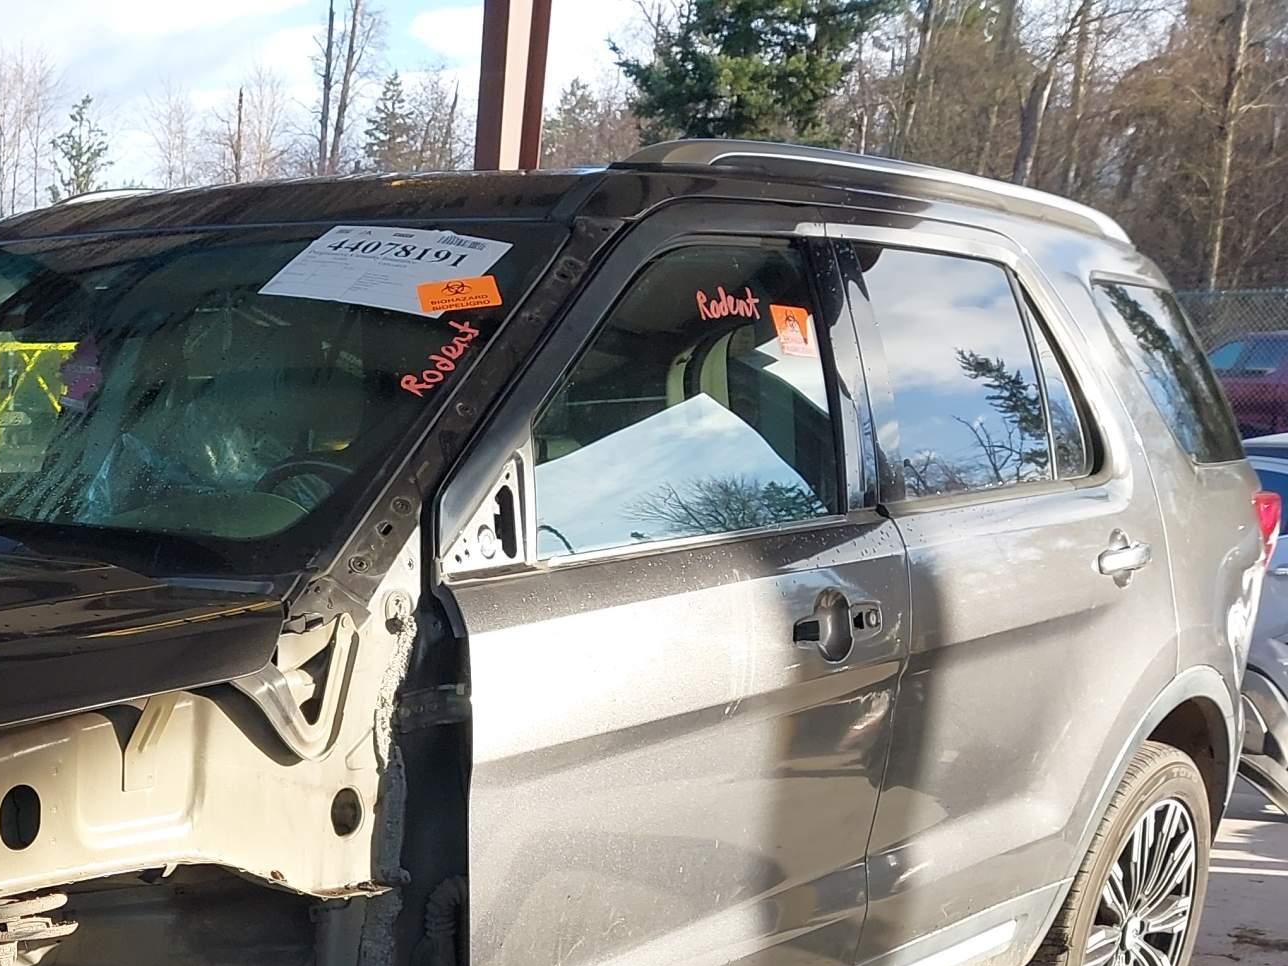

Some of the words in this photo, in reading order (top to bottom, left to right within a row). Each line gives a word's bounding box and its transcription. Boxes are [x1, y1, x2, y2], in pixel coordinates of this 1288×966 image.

[328, 238, 468, 268] 44078191
[430, 294, 489, 305] BIOHAZARD
[432, 299, 491, 311] BIOPELIGRO
[696, 286, 760, 320] Rodent
[400, 320, 480, 397] Rodent
